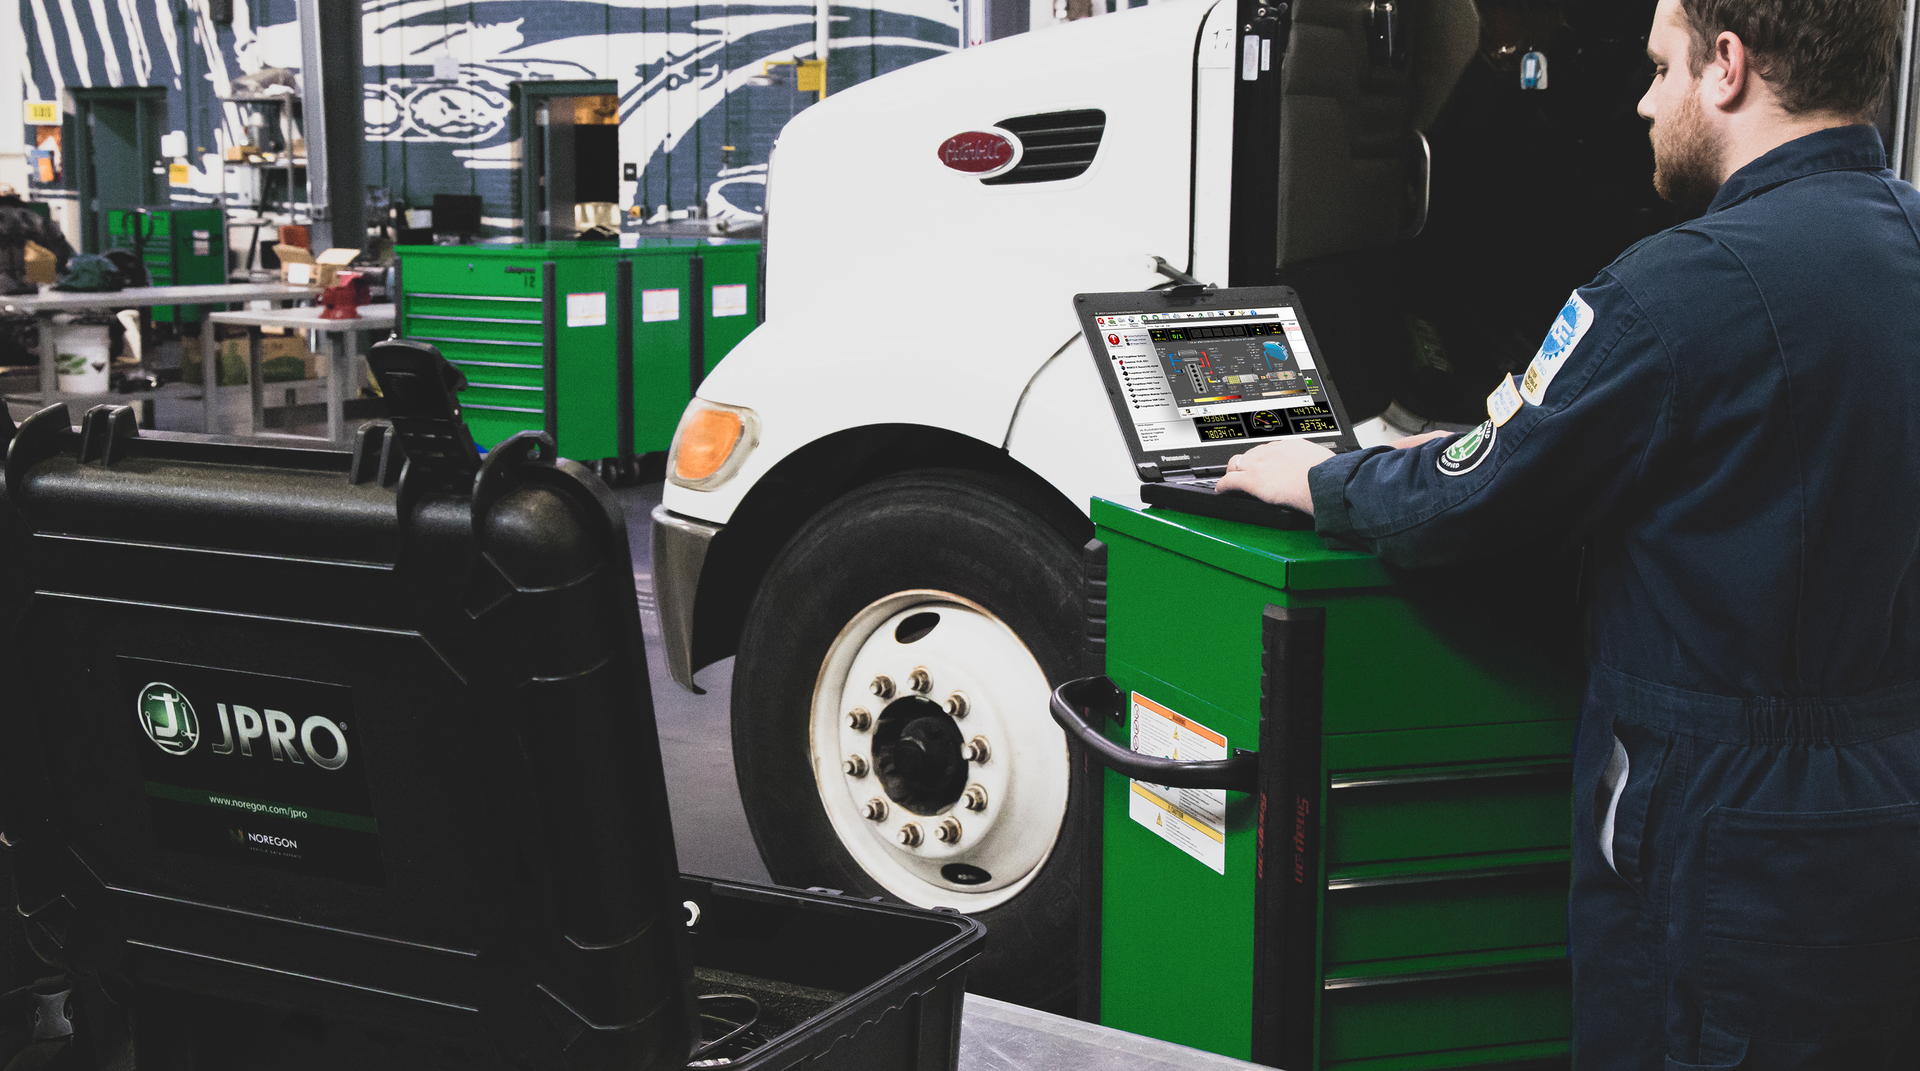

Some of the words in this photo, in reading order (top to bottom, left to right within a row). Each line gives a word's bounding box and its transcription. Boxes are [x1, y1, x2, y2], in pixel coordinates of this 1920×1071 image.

[945, 139, 1006, 163] Peterbilt
[1161, 454, 1190, 462] Panasonic
[209, 796, 307, 819] www.noregon.com/jpro
[248, 832, 298, 849] NOREGON
